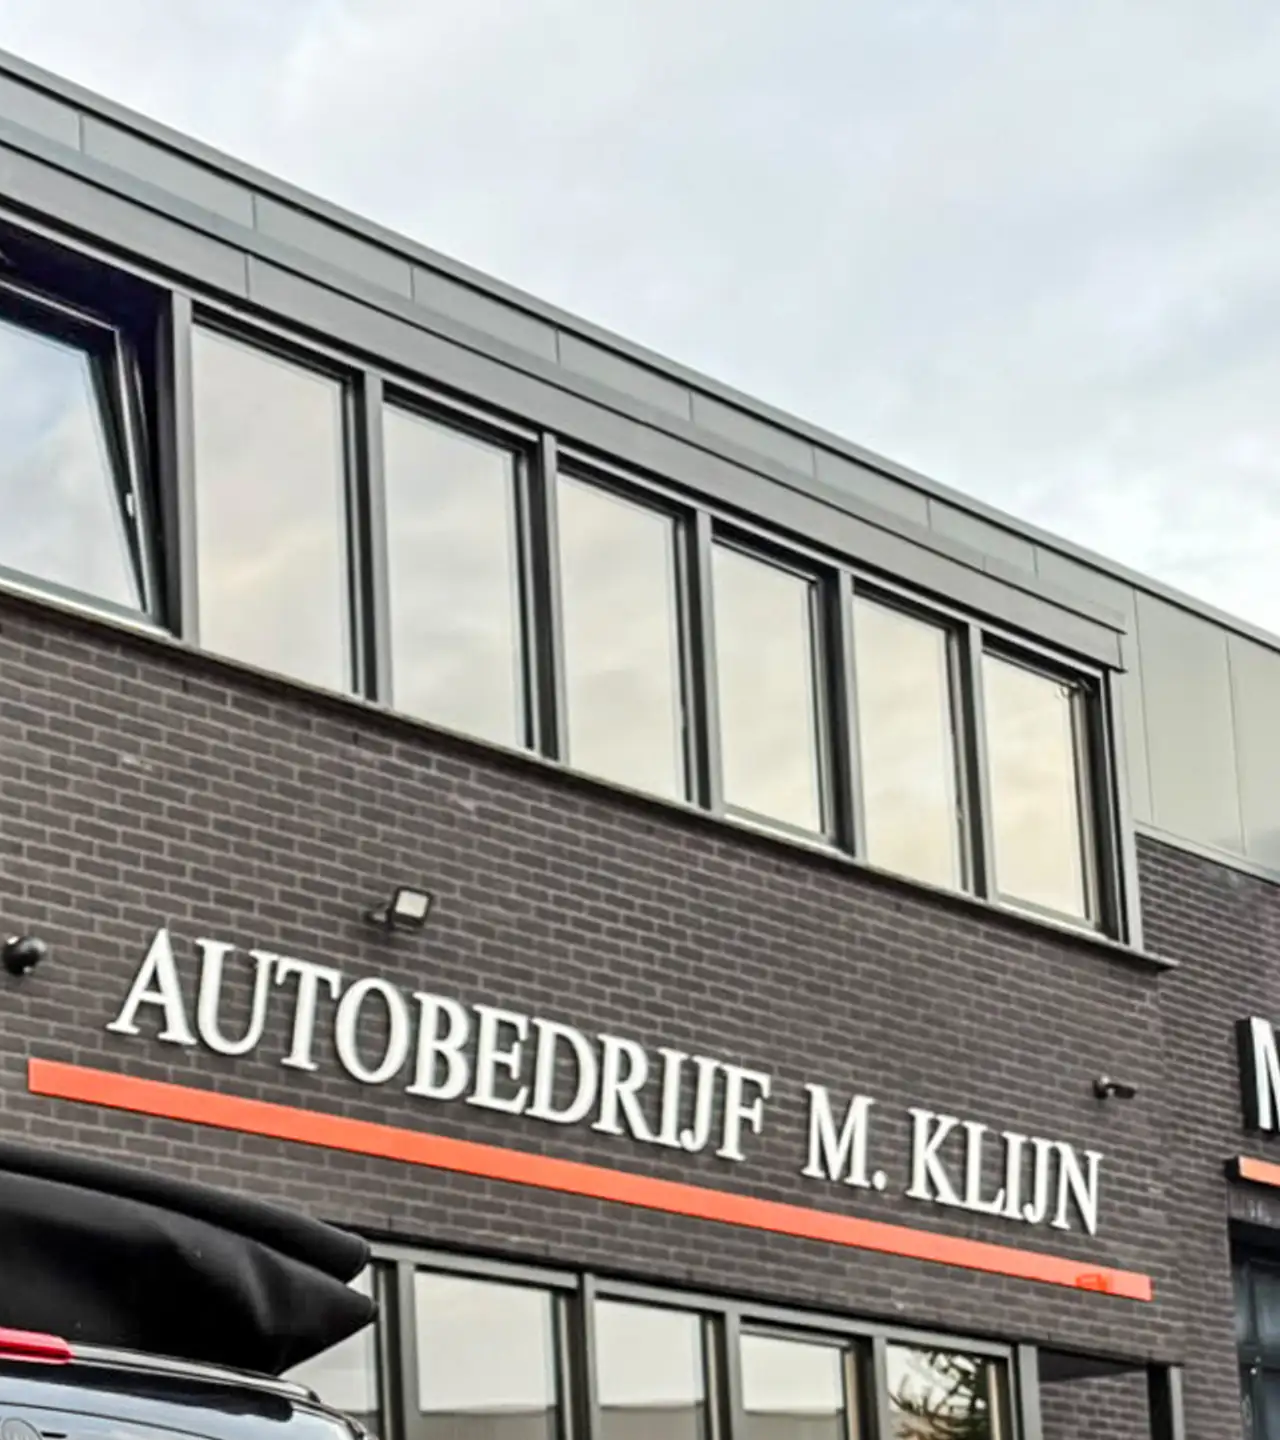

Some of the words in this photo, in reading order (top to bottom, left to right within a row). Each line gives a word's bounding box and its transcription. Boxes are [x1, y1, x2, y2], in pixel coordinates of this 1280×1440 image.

[106, 928, 772, 1162] AUTOBEDRIJF
[802, 1083, 888, 1191] M.
[905, 1108, 1105, 1236] KLIJN
